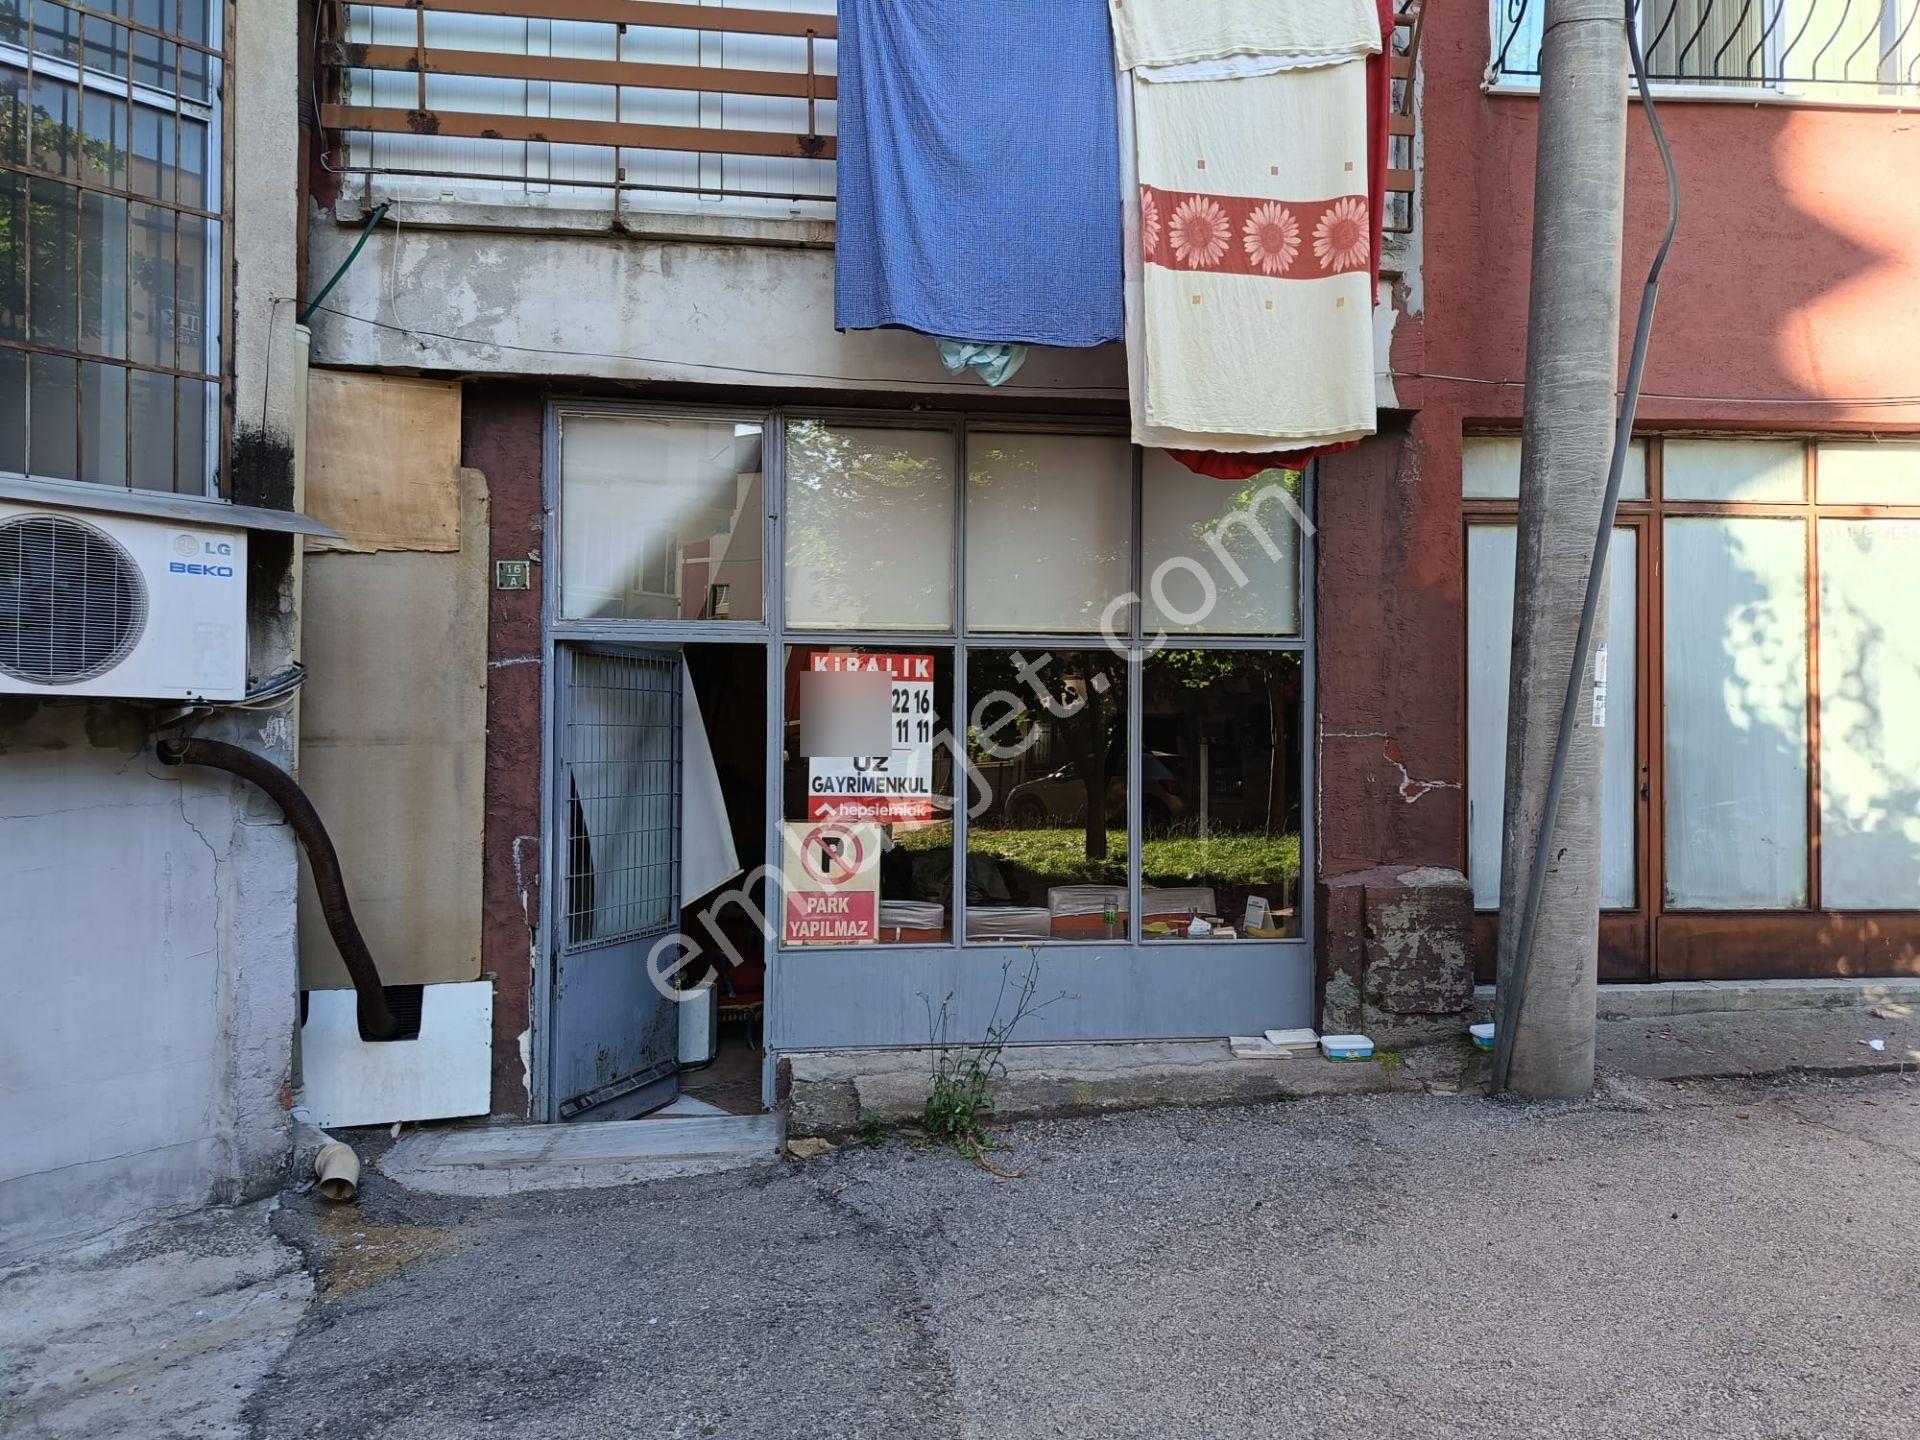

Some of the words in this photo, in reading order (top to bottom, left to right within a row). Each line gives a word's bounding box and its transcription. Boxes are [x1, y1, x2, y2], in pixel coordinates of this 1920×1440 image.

[205, 541, 232, 556] LG
[169, 561, 233, 578] BEKO
[507, 564, 521, 574] 16
[510, 576, 518, 586] A
[914, 689, 930, 714] 16
[896, 718, 909, 743] 11
[917, 719, 929, 743] 11
[811, 771, 929, 794] GAYRİMENKUL
[839, 802, 927, 819] hepsiemlak
[807, 897, 850, 914] PARK
[789, 921, 869, 937] YAPILMAZ
